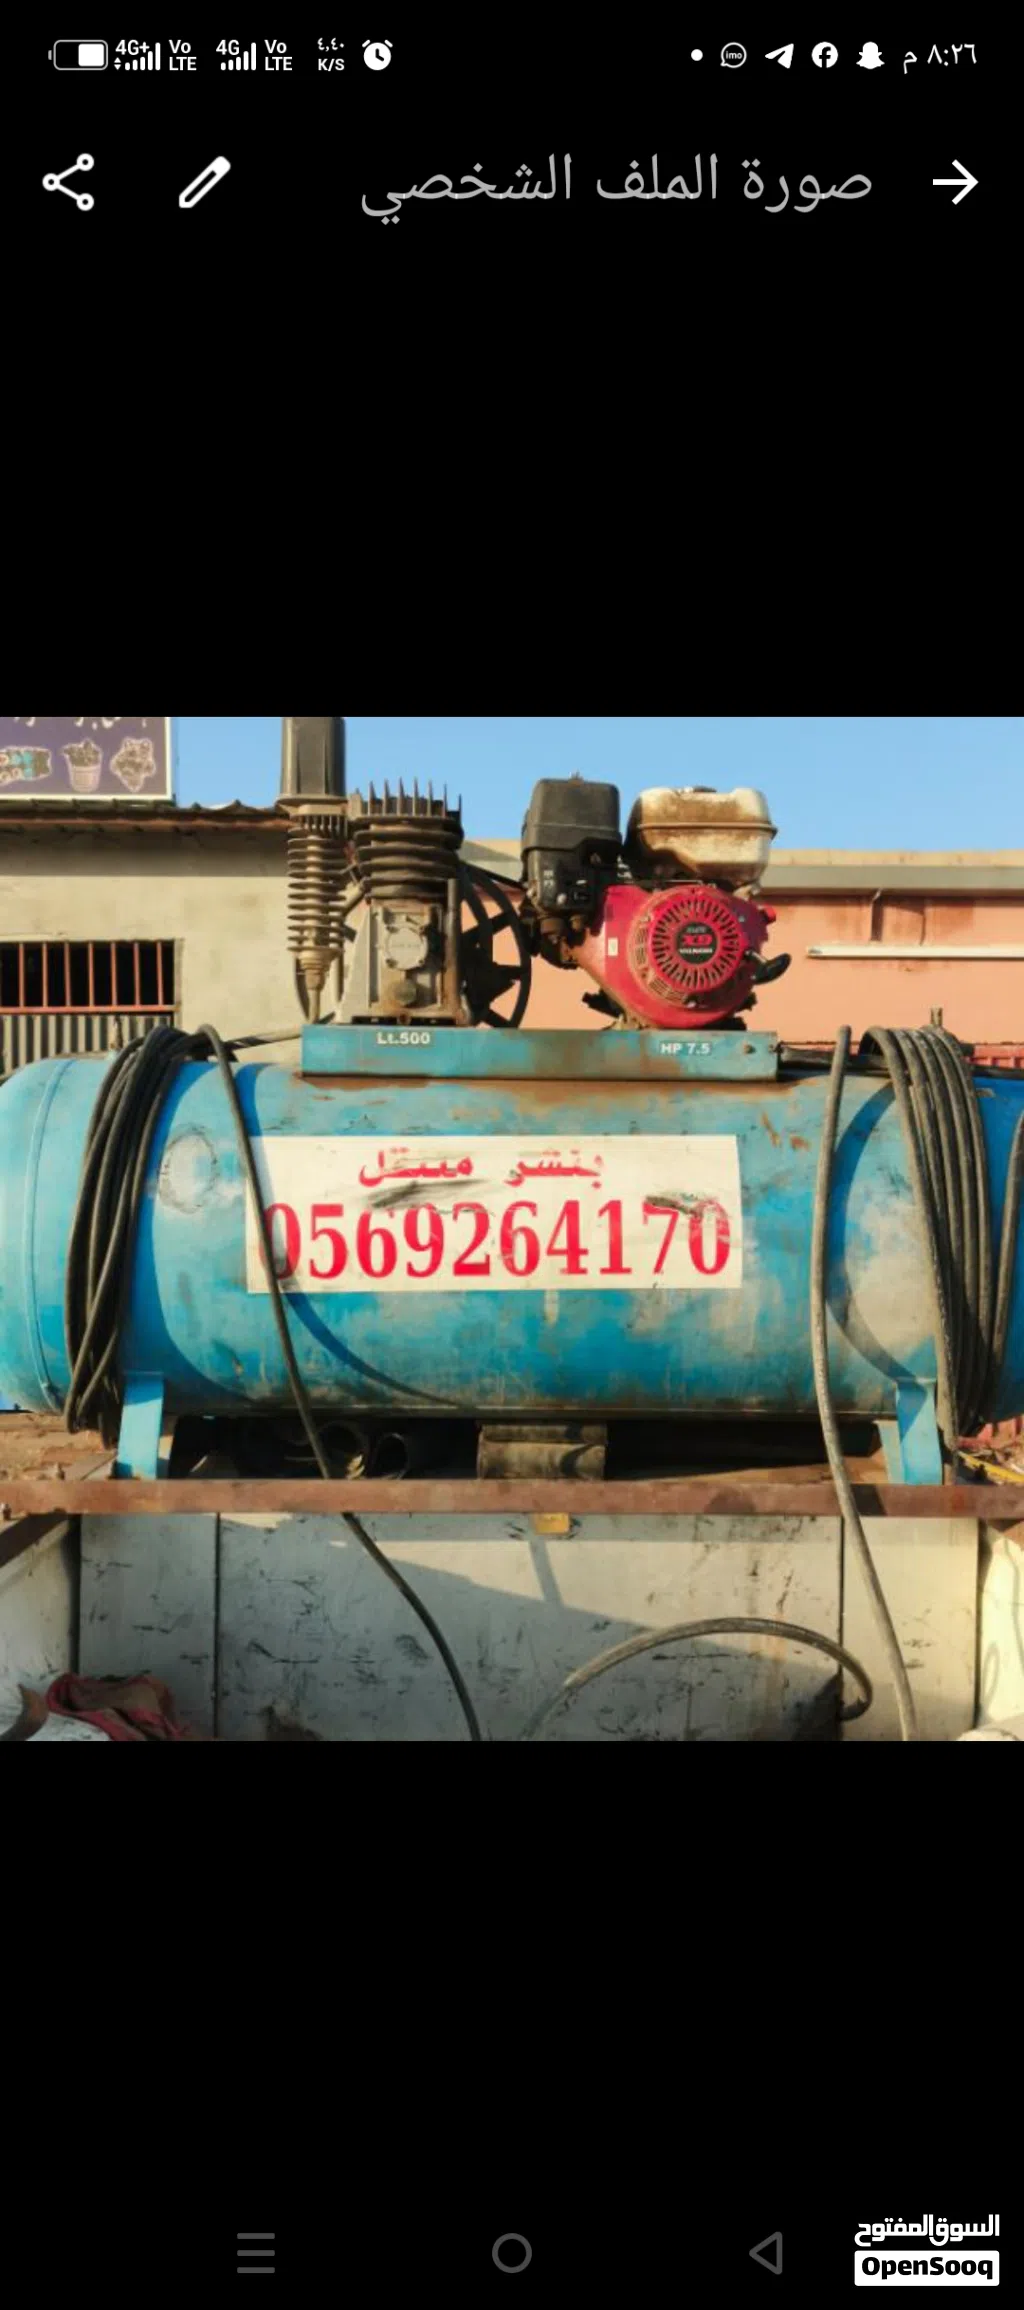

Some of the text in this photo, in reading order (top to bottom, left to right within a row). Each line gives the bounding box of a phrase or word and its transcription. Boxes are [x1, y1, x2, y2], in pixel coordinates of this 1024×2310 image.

[168, 39, 191, 54] Vo
[215, 39, 240, 55] 4G
[264, 39, 287, 54] Vo
[169, 57, 197, 71] LTE
[264, 57, 293, 71] LTE
[317, 58, 345, 72] K/S
[903, 51, 918, 75] م
[361, 153, 872, 226] صورة الملف الشخصي
[660, 1042, 710, 1055] HP 7.5
[258, 1198, 731, 1280] 0569264170
